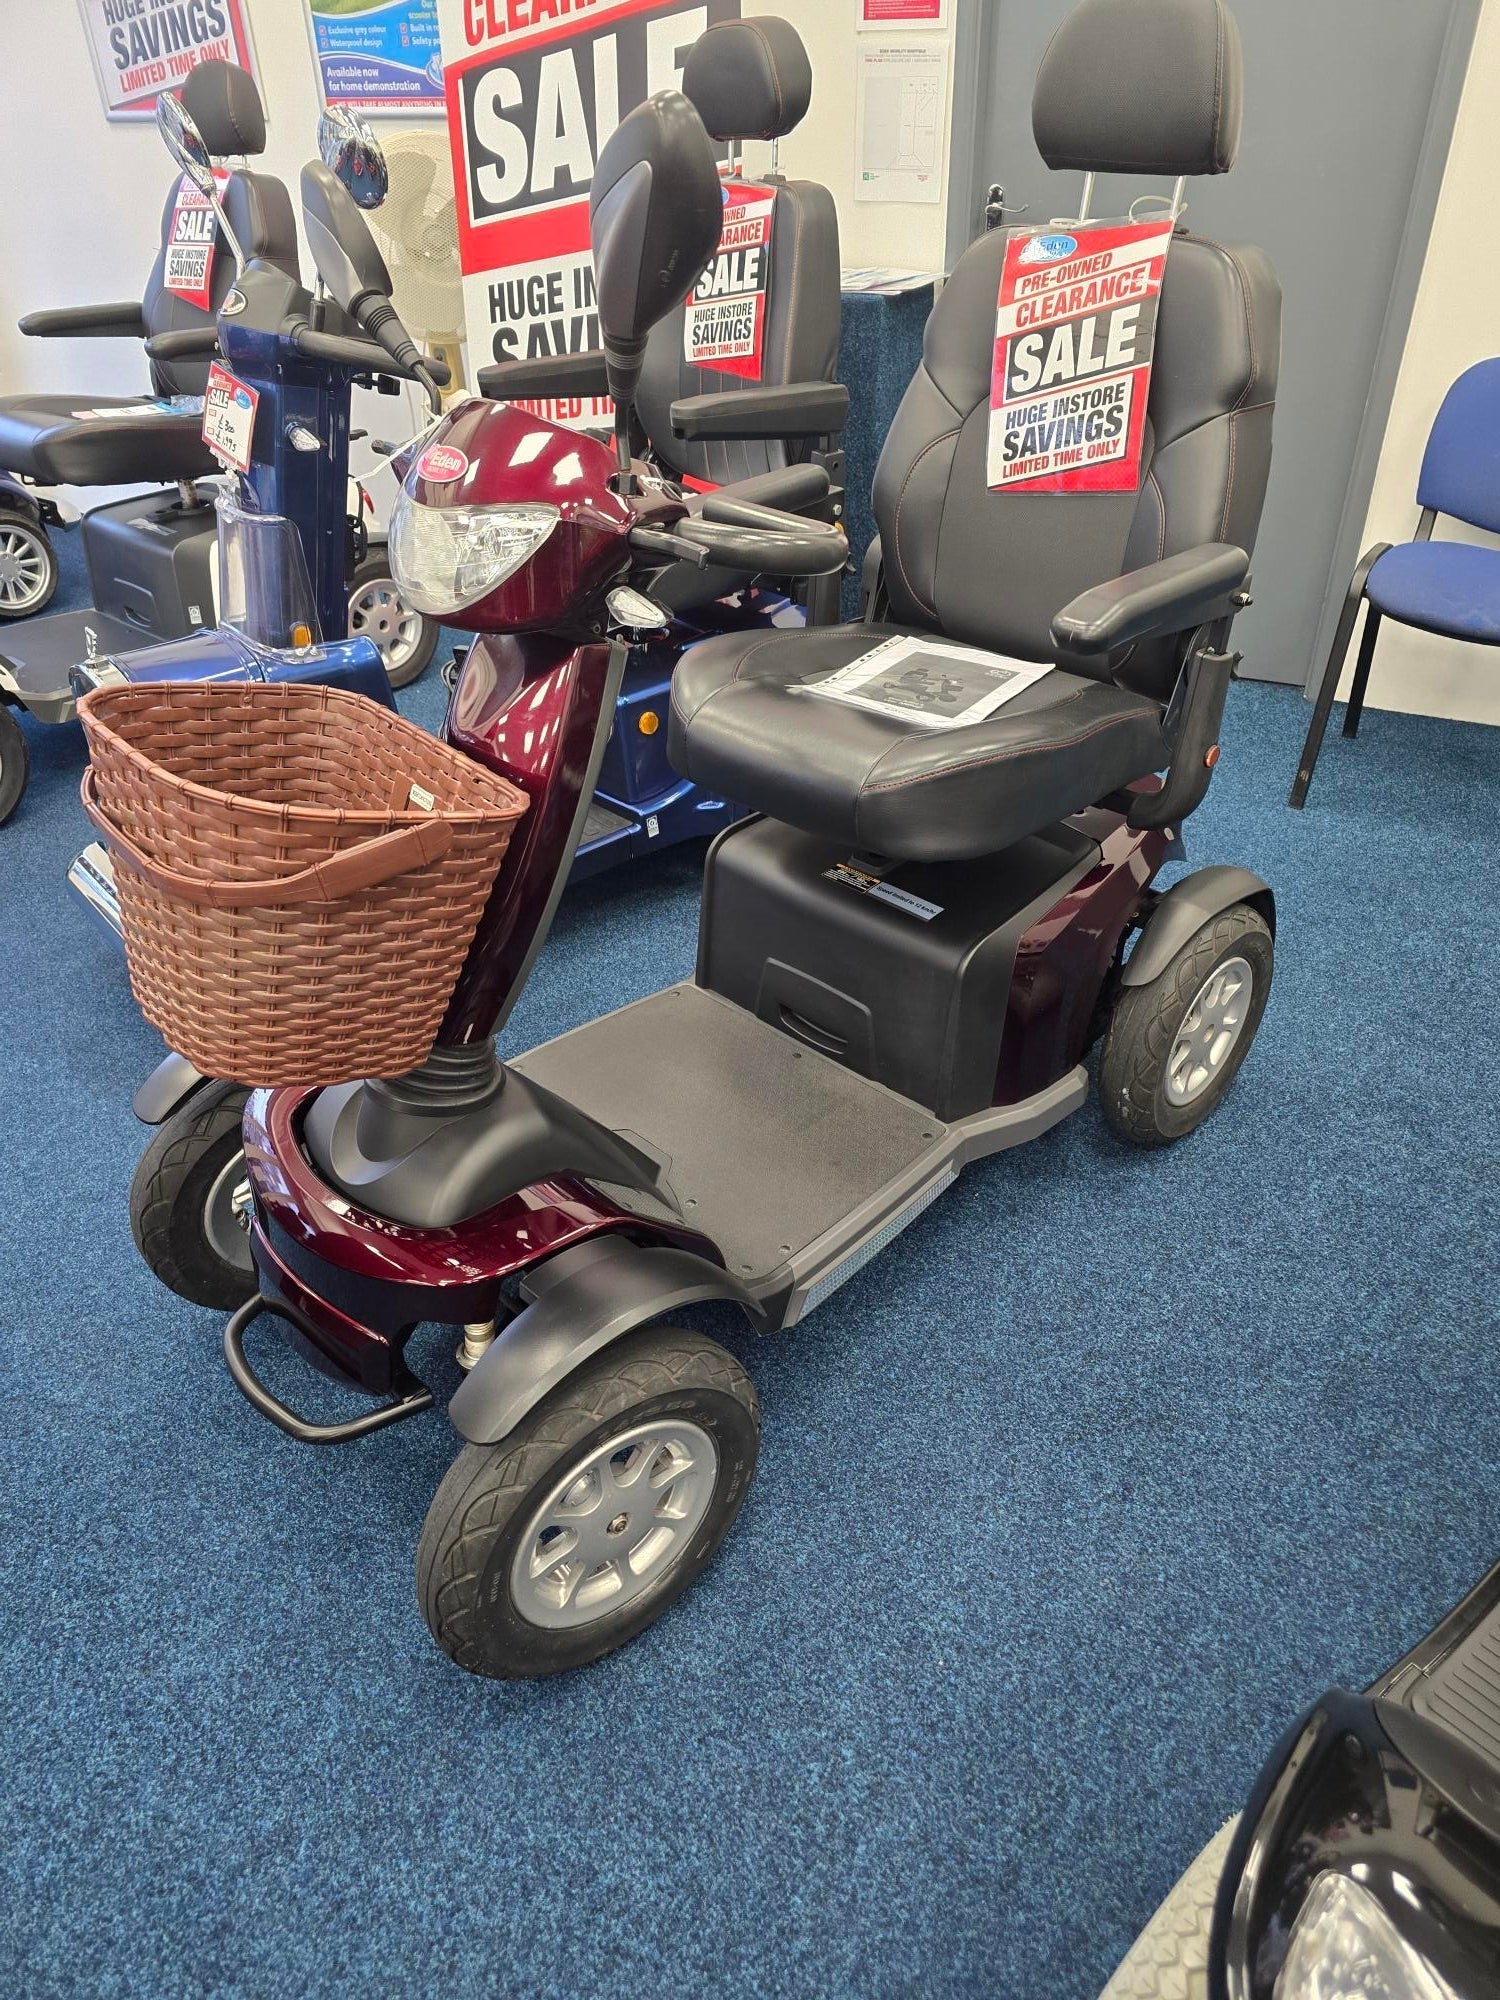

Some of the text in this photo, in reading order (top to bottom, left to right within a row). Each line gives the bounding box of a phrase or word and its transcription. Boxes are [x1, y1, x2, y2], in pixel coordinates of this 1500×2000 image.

[109, 0, 226, 70] SAVINGS
[327, 25, 353, 34] Exclusive
[368, 24, 387, 33] colour
[328, 38, 383, 48] Waterproof design
[119, 39, 229, 93] LIMITED TIME ONLY
[327, 66, 379, 77] Available now
[328, 80, 421, 91] for home demonstration
[175, 210, 215, 241] SALE
[169, 259, 205, 278] SAVINGS
[696, 247, 760, 298] SALE
[1021, 252, 1113, 295] PRE-OWNED
[488, 270, 564, 324] HUGE
[1015, 264, 1147, 329] CLEARANCE
[694, 301, 753, 324] HUGE INSTORE
[692, 316, 752, 346] SAVINGS
[692, 341, 751, 358] LIMITED TIME ONLY
[1011, 303, 1141, 393] SALE
[210, 388, 230, 406] SALE
[1005, 382, 1126, 430] HUGE INSTORE
[1002, 404, 1124, 462] SAVINGS
[430, 450, 463, 472] Eden
[1002, 438, 1121, 479] LIMITED TIME ONLY
